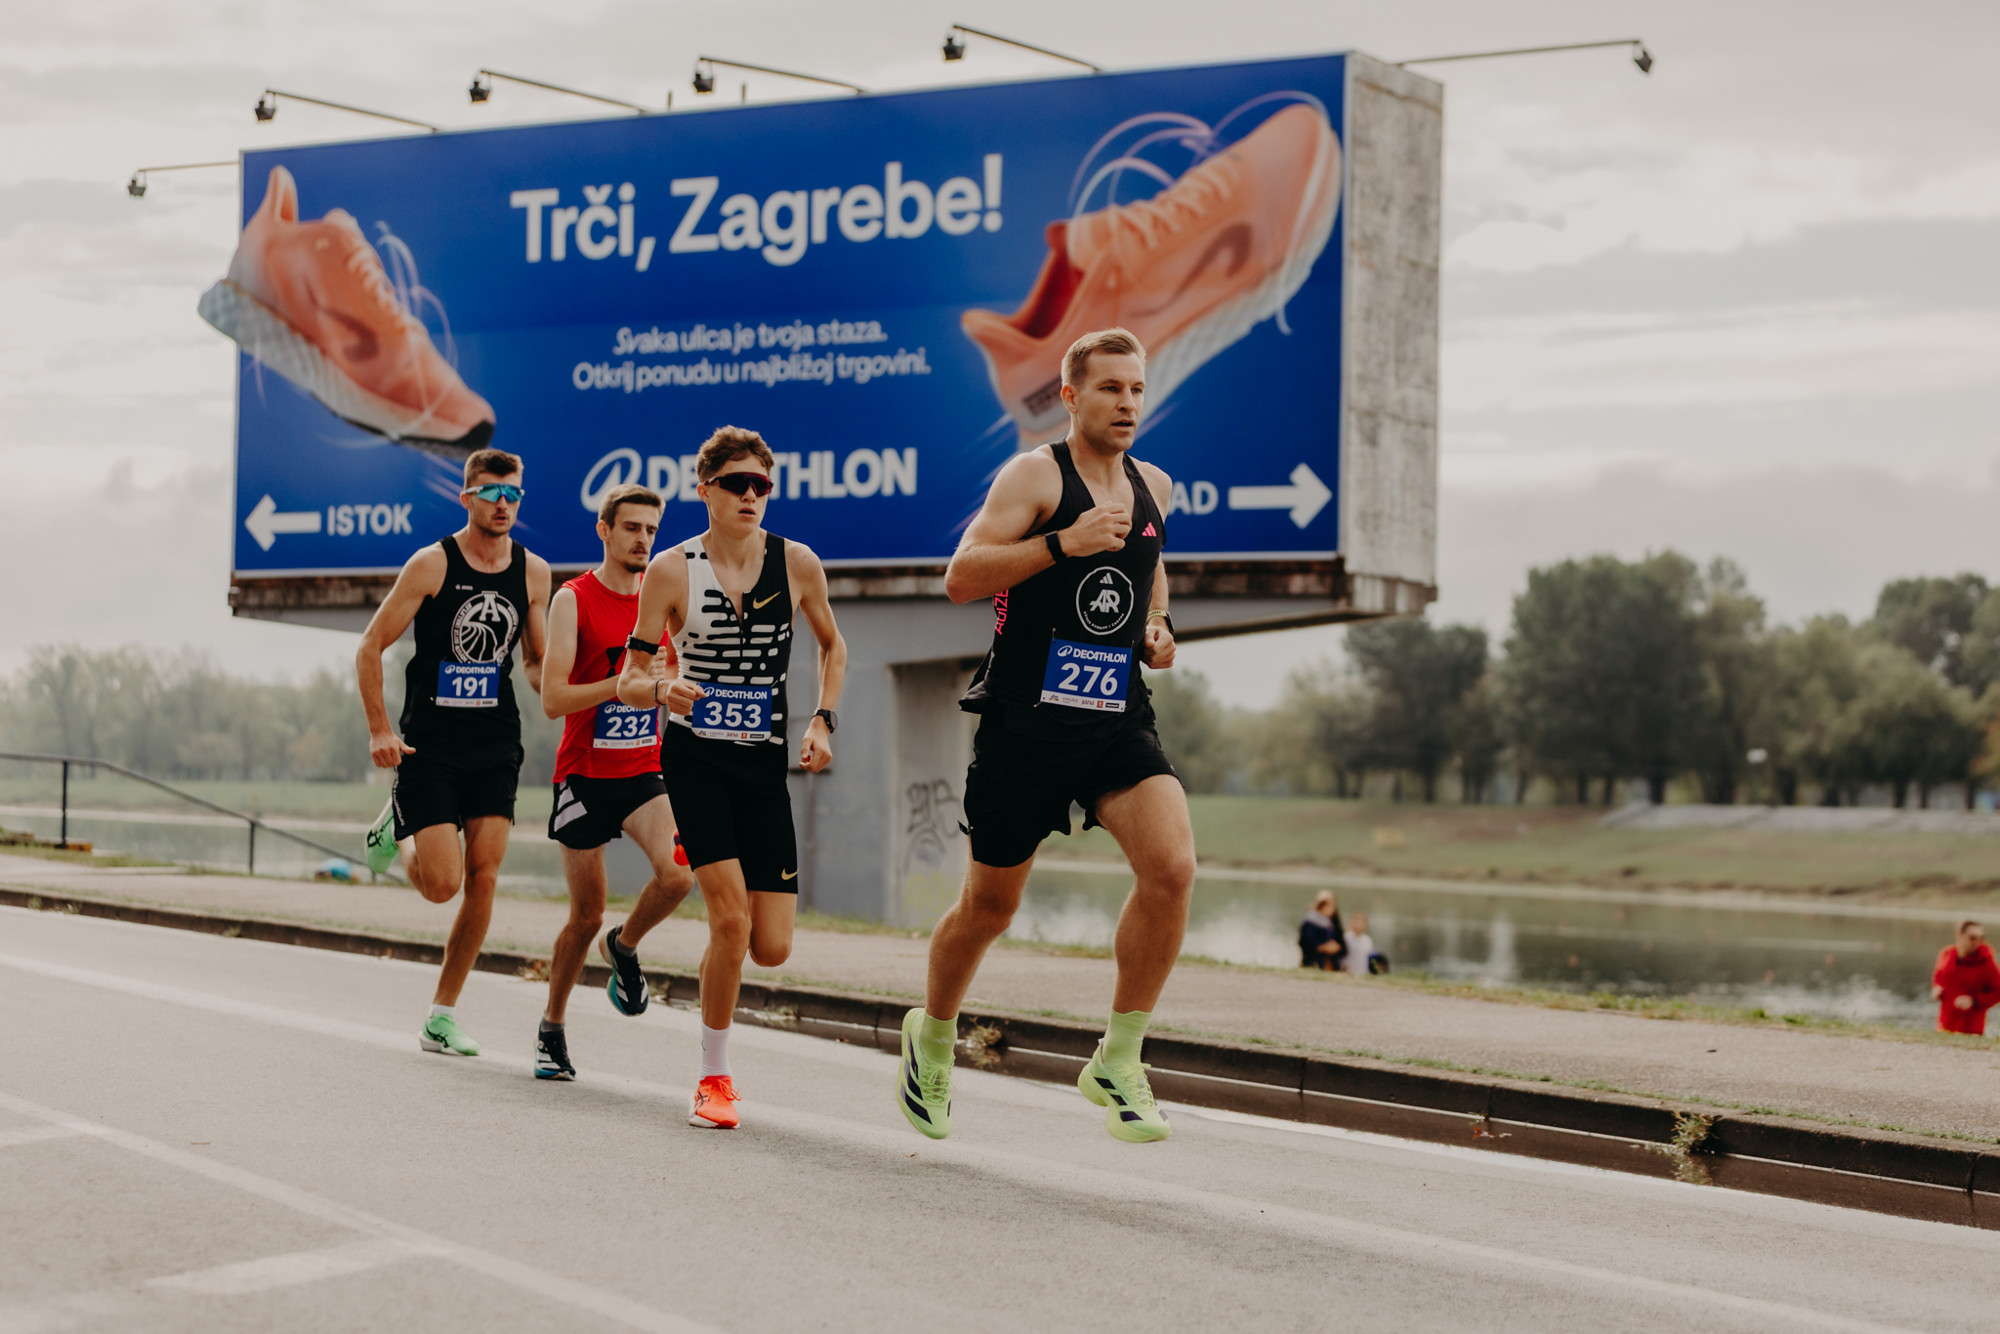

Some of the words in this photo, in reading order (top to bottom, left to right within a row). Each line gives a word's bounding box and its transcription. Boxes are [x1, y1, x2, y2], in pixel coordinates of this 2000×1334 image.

[510, 182, 656, 272] Trči,
[669, 153, 1003, 267] Zagrebe!
[613, 326, 679, 355] Svaka
[680, 323, 732, 353] ulica
[731, 322, 756, 356] je
[757, 319, 815, 353] tvoja
[816, 319, 888, 346] staza.
[572, 360, 634, 394] Otkrij
[635, 357, 722, 393] ponudu
[723, 362, 739, 384] u
[741, 352, 834, 388] najbližoj
[836, 346, 931, 384] trgovini.
[647, 447, 917, 502] DETHLON
[327, 503, 413, 537] ISTOK
[994, 589, 1009, 636] ADIZE
[455, 666, 497, 674] DECATHLON
[1073, 648, 1127, 664] DECATHLON
[452, 676, 488, 697] 191
[715, 688, 767, 700] DECATHLON
[1058, 662, 1118, 696] 276
[606, 714, 651, 738] 232
[704, 701, 762, 728] 353
